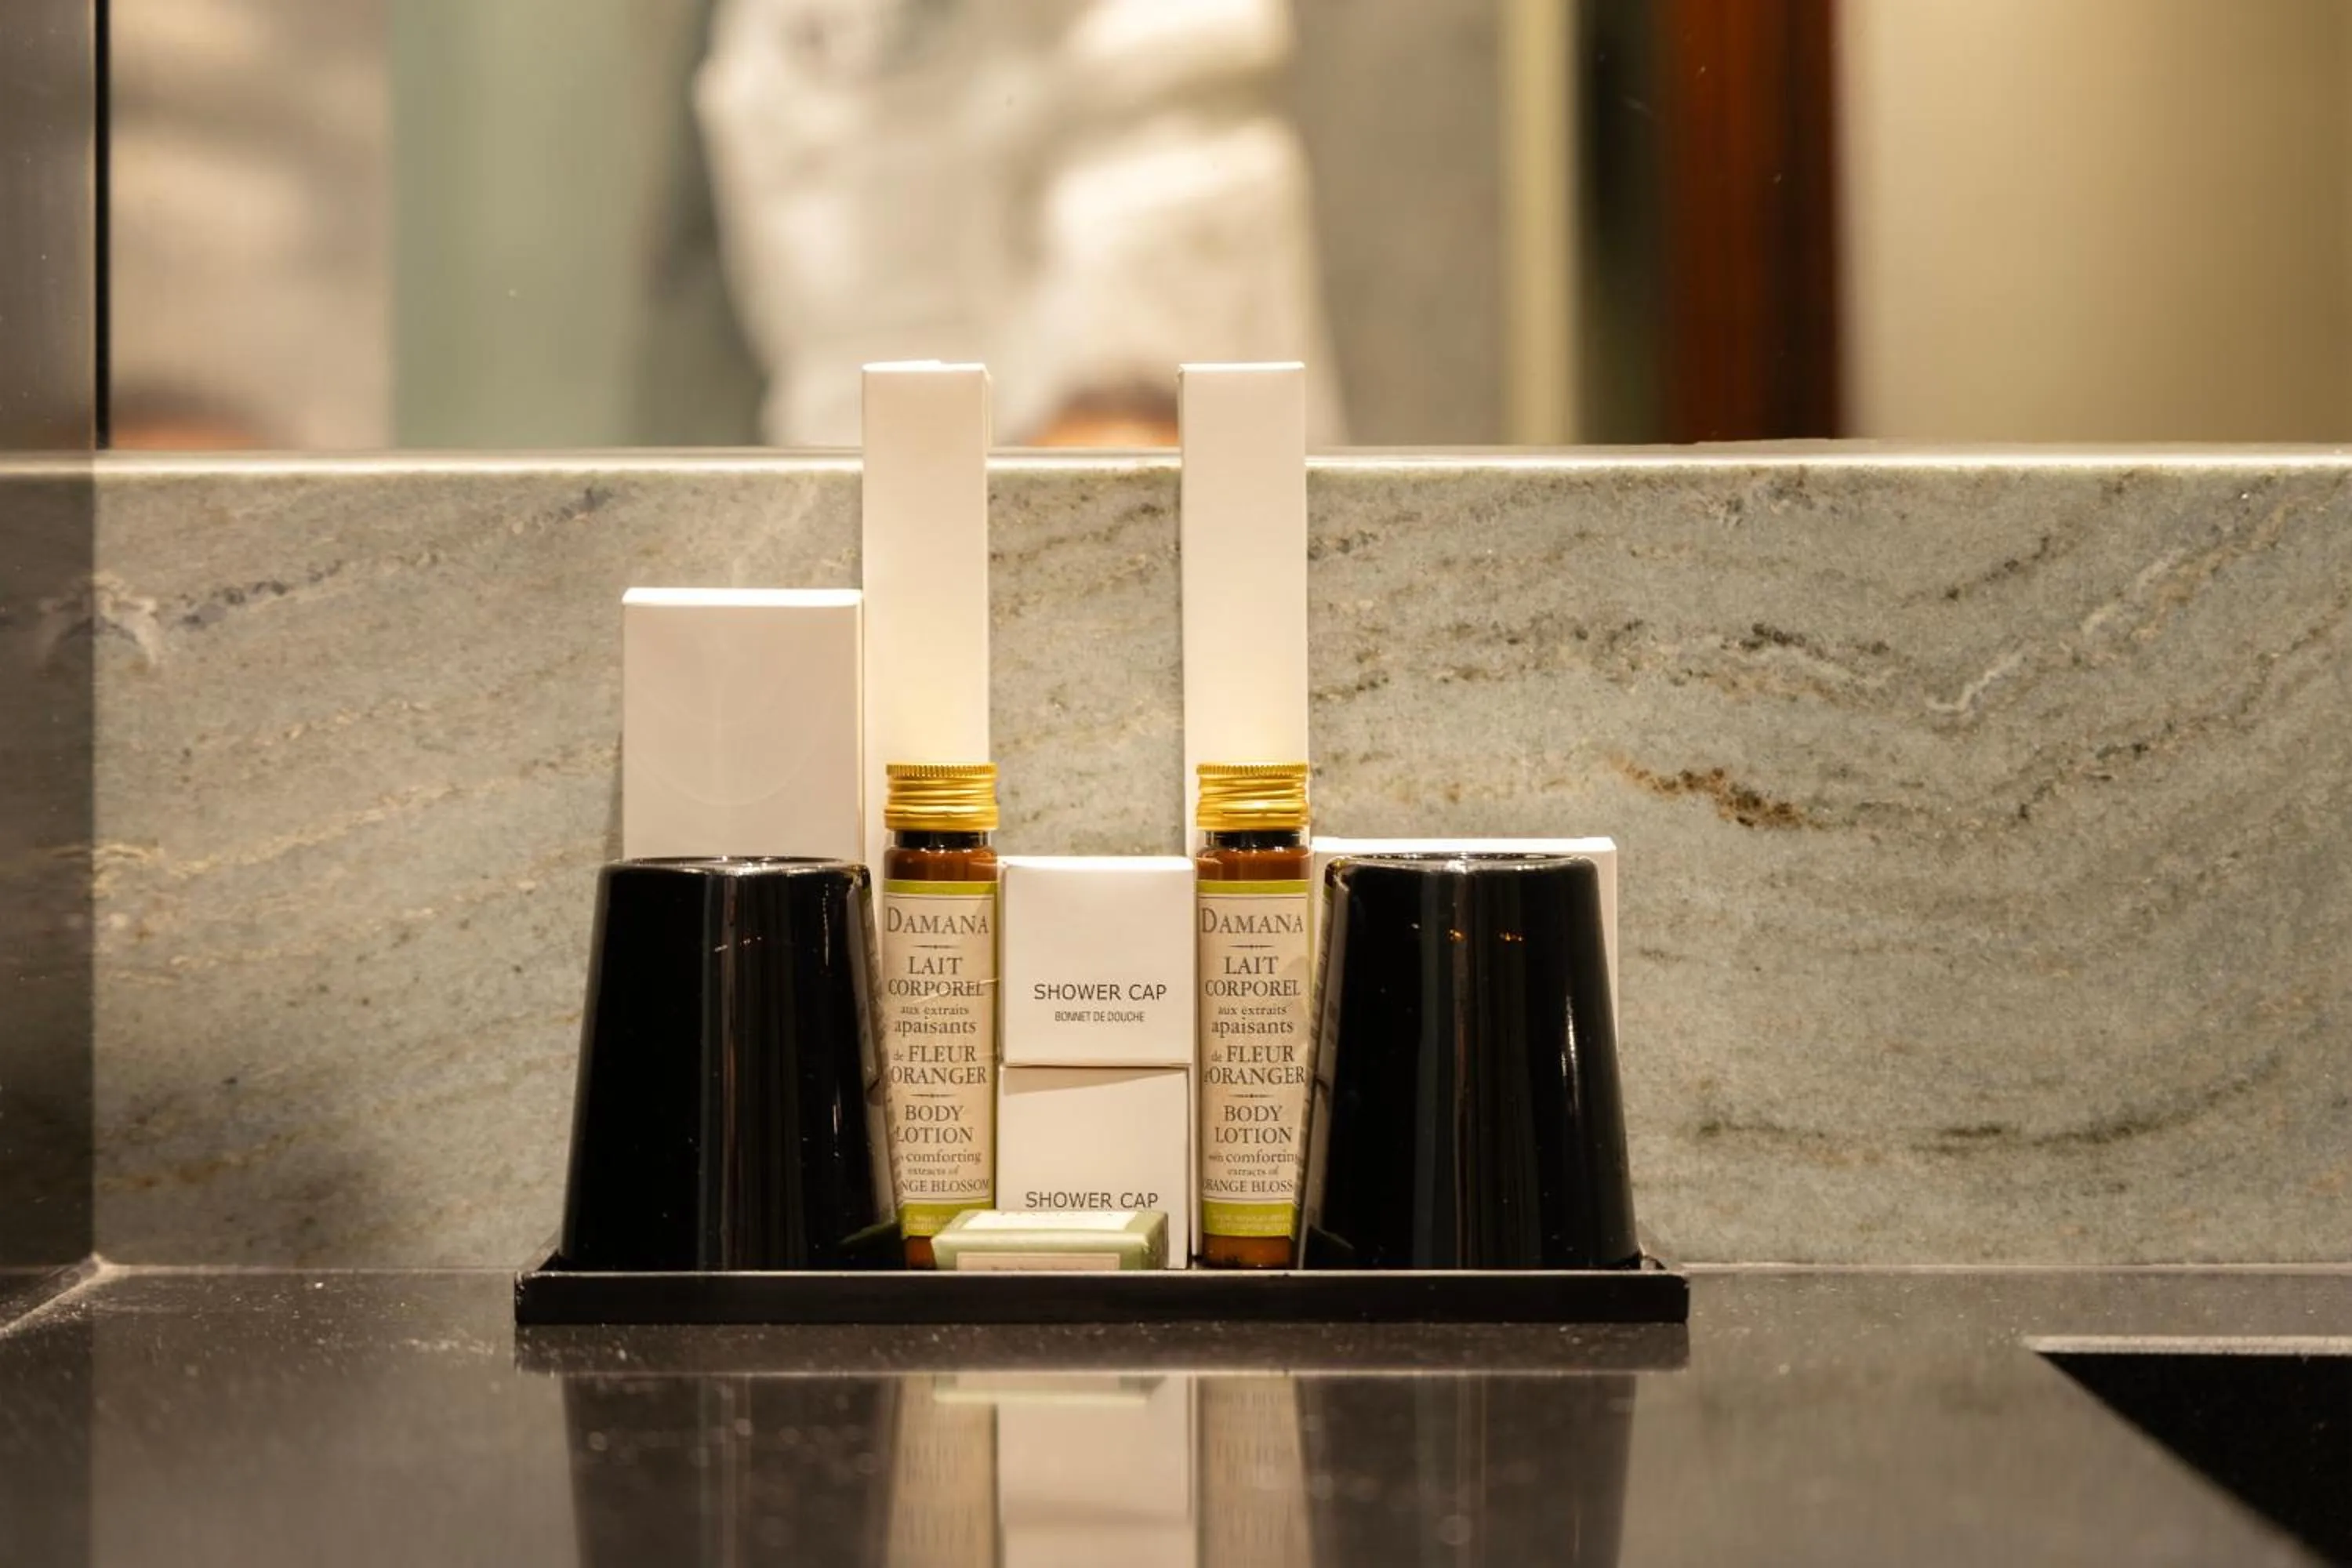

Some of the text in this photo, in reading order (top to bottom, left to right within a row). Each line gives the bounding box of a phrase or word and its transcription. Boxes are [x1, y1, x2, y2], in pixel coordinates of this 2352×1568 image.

[887, 906, 989, 934] DAMANA
[1201, 906, 1305, 934] DAMANA
[908, 956, 964, 975] LAIT
[1224, 956, 1279, 975] LAIT
[888, 978, 985, 996] CORPOREL
[1033, 983, 1167, 1000] SHOWER CAP
[1205, 979, 1301, 997] CORPOREL
[924, 1004, 970, 1015] extraits
[1054, 1011, 1145, 1022] BONNET DE DOUCHE
[894, 1016, 977, 1037] apaisants
[1211, 1016, 1295, 1038] apaisants
[909, 1045, 978, 1062] FLEUR
[1226, 1045, 1295, 1063] FLEUR
[905, 1105, 964, 1122] BODY
[1224, 1105, 1283, 1122] BODY
[896, 1125, 974, 1144] LOTION
[1215, 1126, 1293, 1144] LOTION
[906, 1149, 982, 1164] comforting
[901, 1178, 927, 1192] NGE
[1203, 1178, 1293, 1192] RANGE BLOSS
[1025, 1191, 1159, 1208] SHOWER CAP
